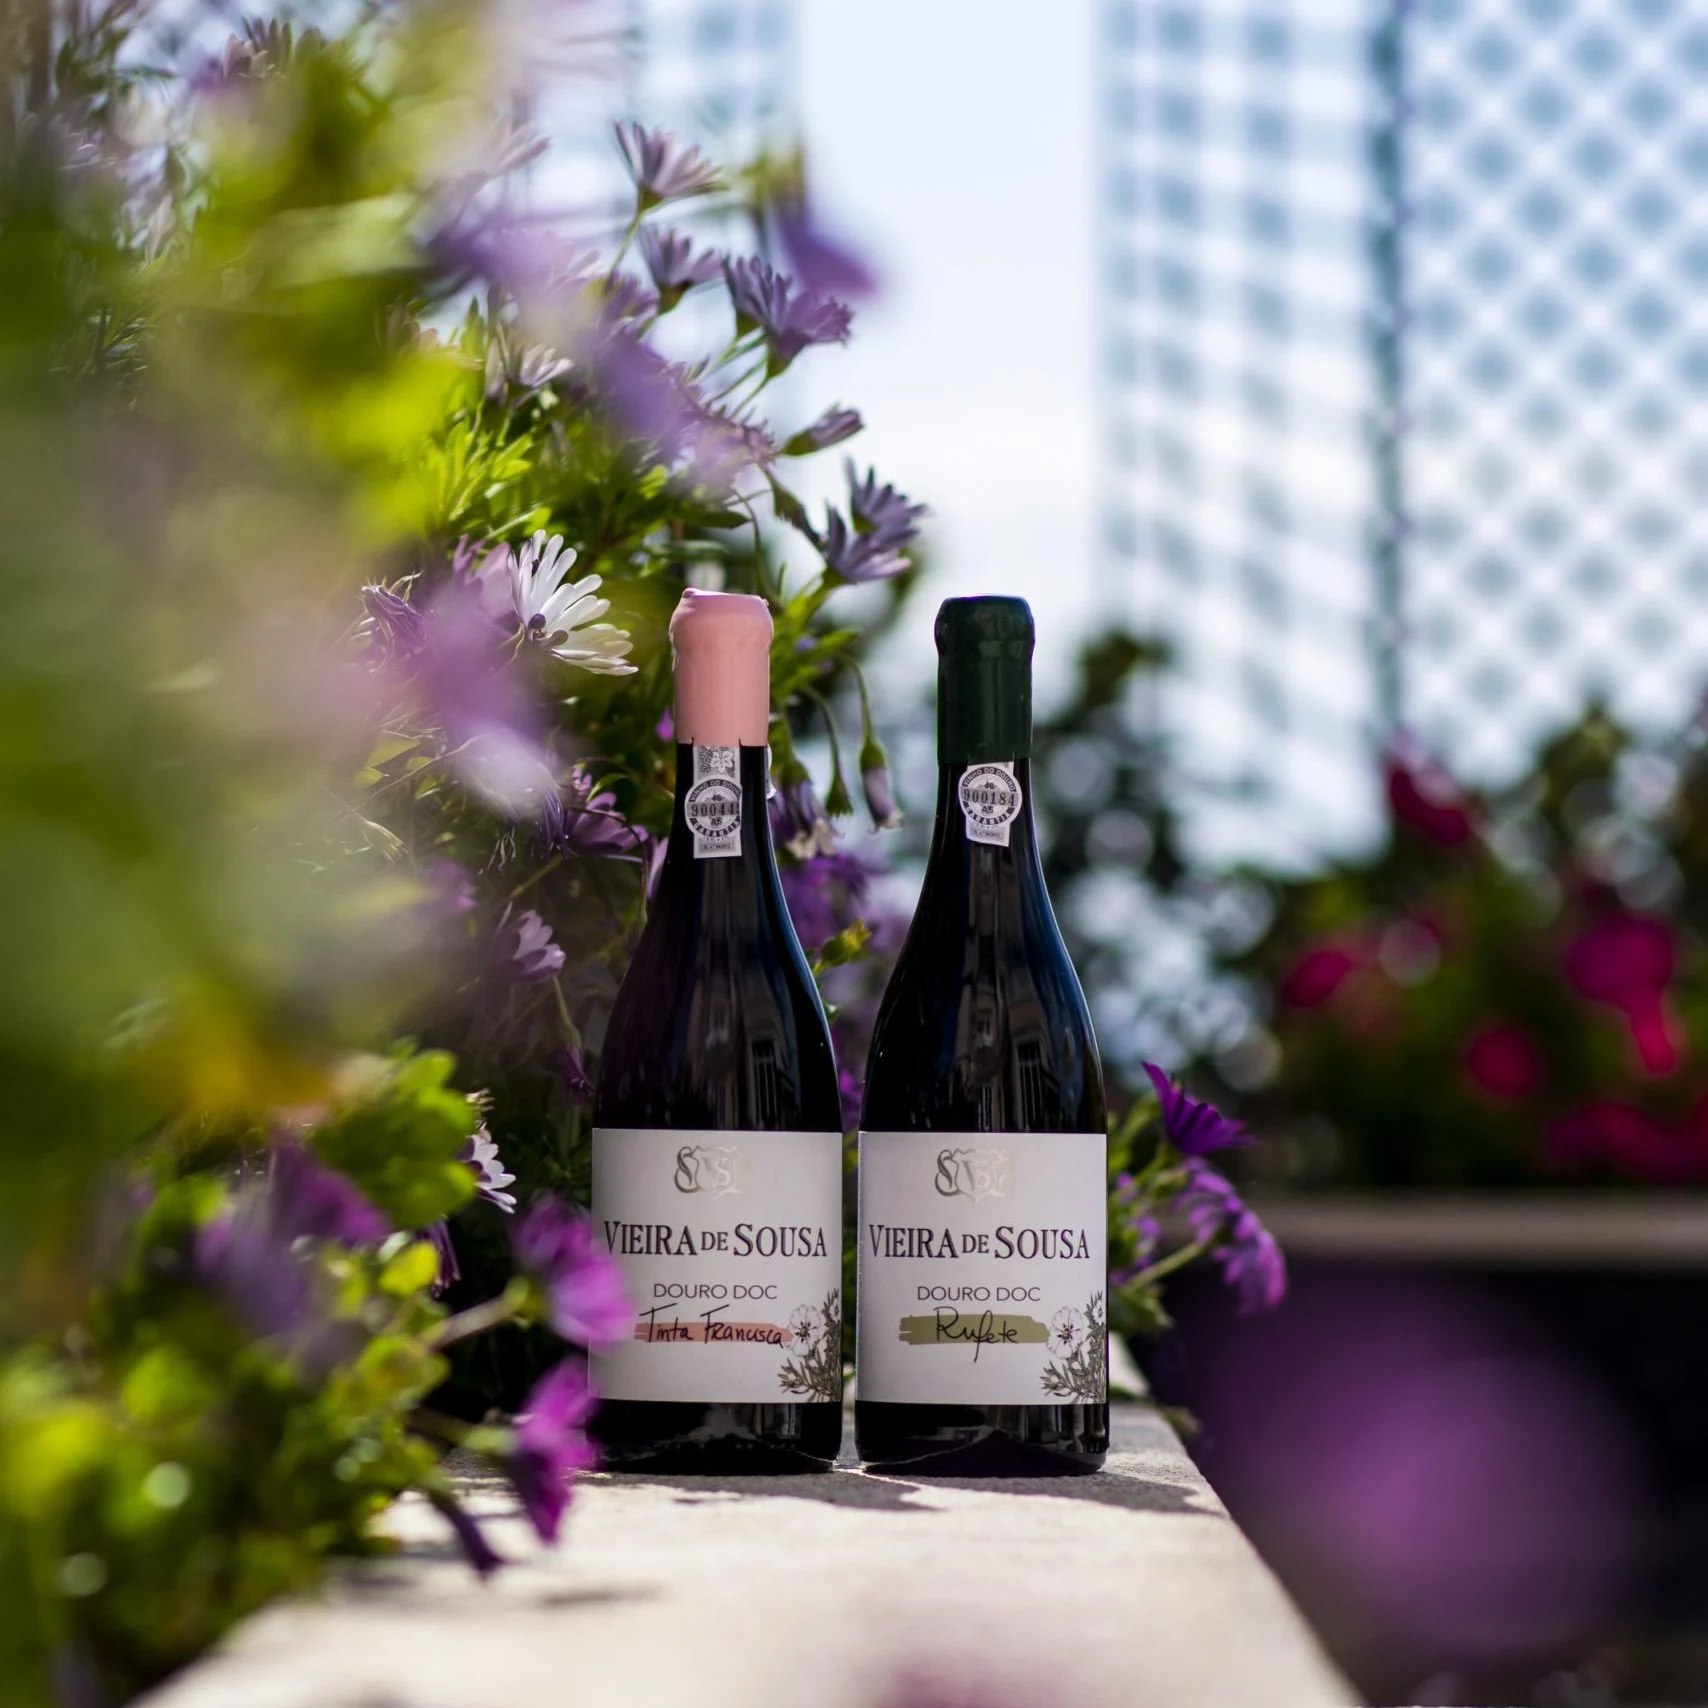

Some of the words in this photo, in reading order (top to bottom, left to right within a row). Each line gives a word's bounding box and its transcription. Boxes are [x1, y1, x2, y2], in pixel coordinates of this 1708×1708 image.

[963, 789, 1015, 806] 900184
[604, 1220, 698, 1255] VIEIRA
[701, 1231, 729, 1251] DE
[733, 1223, 827, 1257] SOUSA
[868, 1224, 959, 1258] VIEIRA
[961, 1234, 989, 1254] DE
[994, 1226, 1090, 1259] SOUSA
[653, 1283, 728, 1299] DOURO
[733, 1284, 778, 1299] DOC
[917, 1286, 990, 1301] DOURO
[996, 1287, 1041, 1301] DOC
[638, 1303, 694, 1343] Tinta
[933, 1306, 1019, 1364] Rufete
